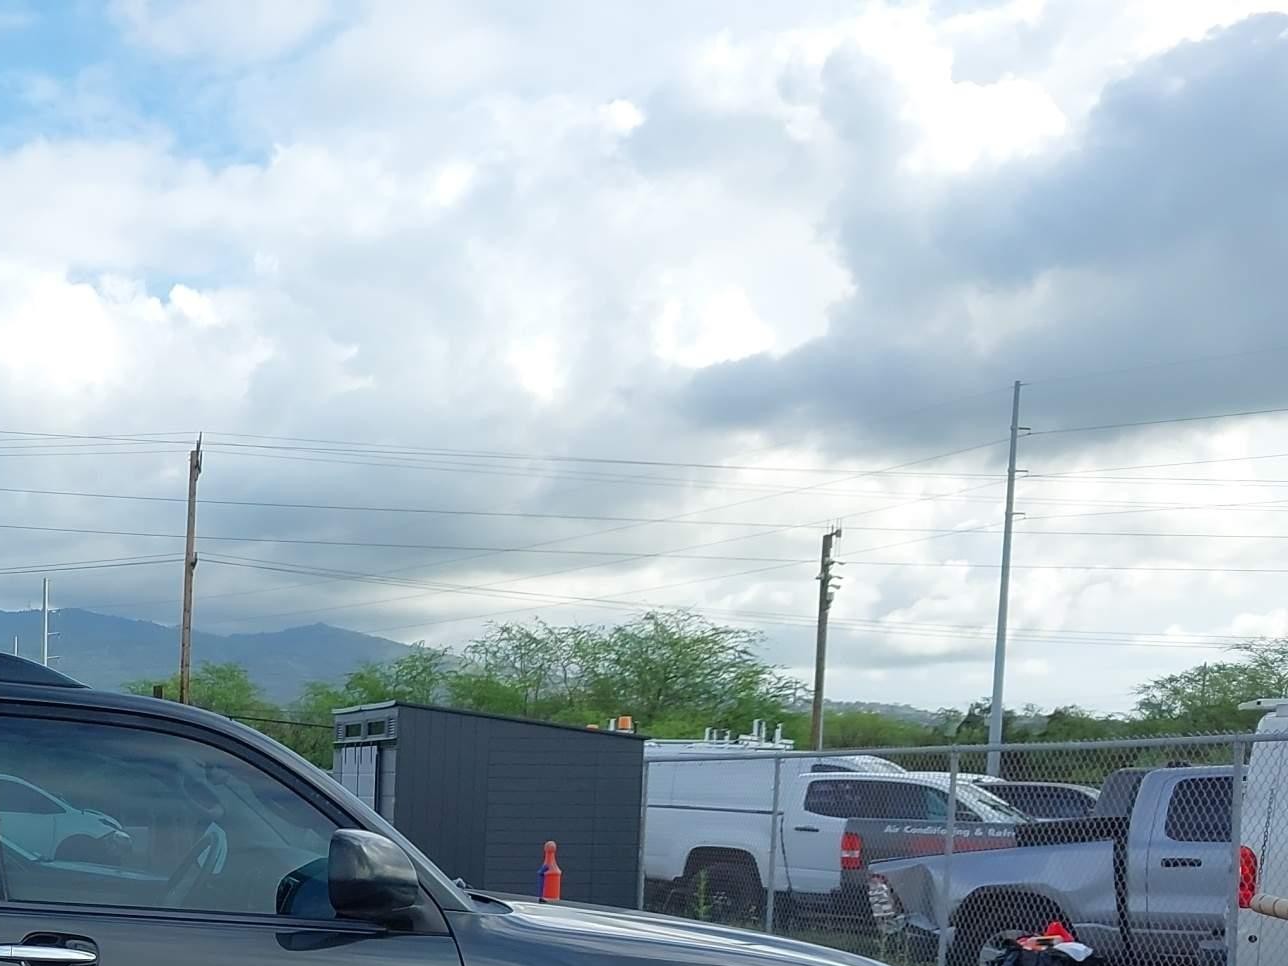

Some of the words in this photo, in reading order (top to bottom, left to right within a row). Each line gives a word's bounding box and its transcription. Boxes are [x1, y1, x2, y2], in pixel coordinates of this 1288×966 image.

[884, 825, 900, 833] Air
[903, 825, 970, 837] Conditioing
[974, 827, 983, 836] &
